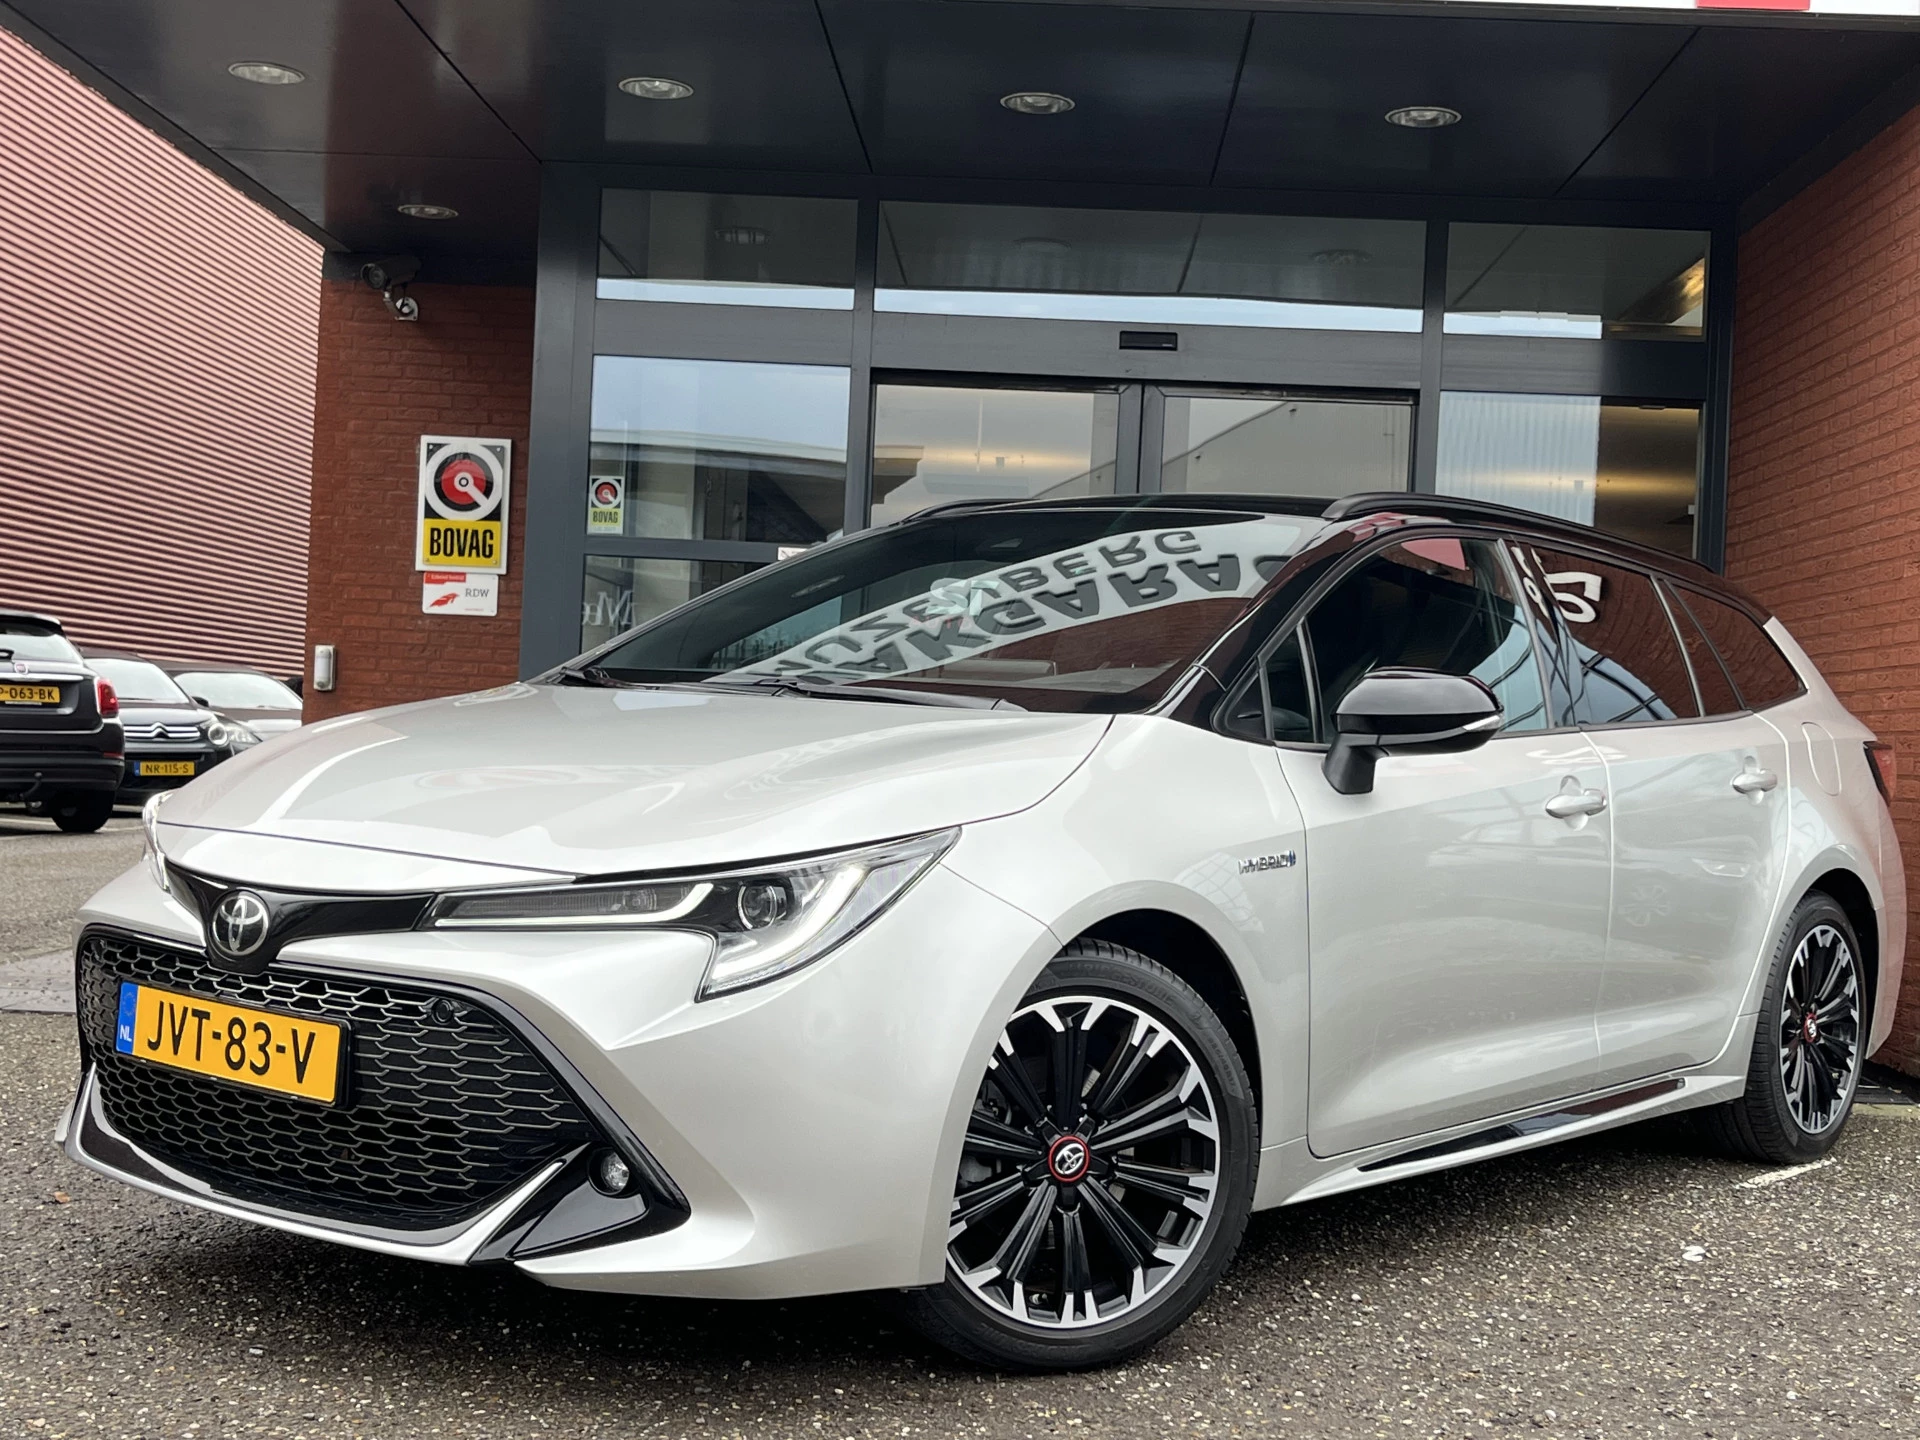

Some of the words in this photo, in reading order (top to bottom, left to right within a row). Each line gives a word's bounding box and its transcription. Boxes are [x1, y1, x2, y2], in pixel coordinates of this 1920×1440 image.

[593, 511, 618, 523] BOVAG
[430, 527, 494, 559] BOVAG
[465, 588, 490, 598] RDW
[145, 763, 189, 774] NR-115-S
[1238, 852, 1290, 875] HYBRID
[120, 1024, 132, 1042] NL
[147, 1000, 316, 1084] JVT-83-V
